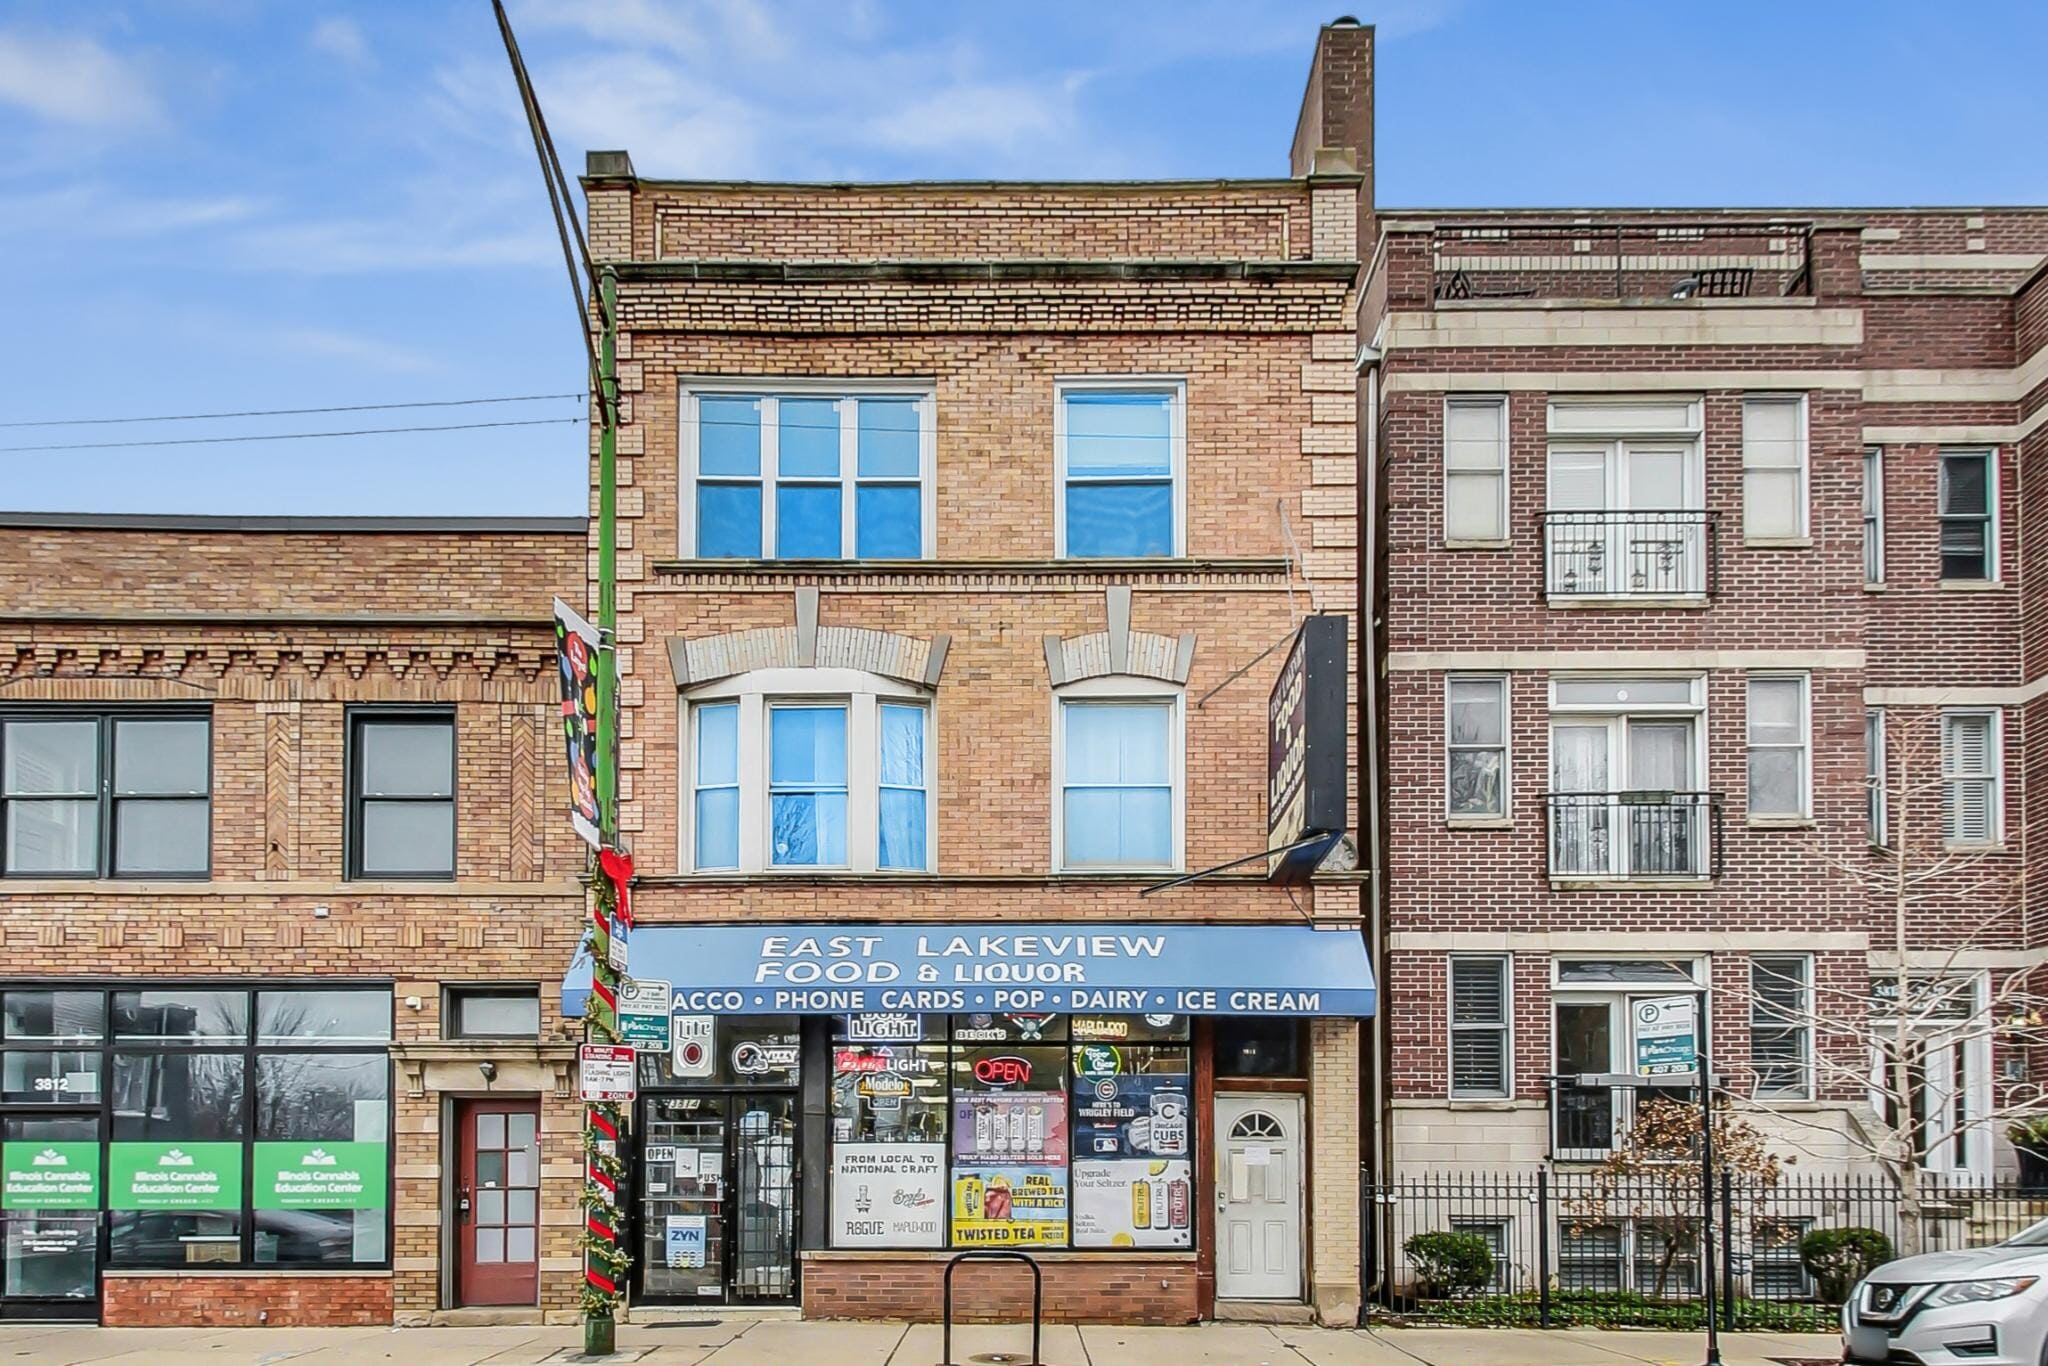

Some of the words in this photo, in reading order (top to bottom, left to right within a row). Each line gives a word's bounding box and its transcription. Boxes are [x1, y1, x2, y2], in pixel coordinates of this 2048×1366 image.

[1275, 672, 1302, 743] FOOD
[1270, 724, 1305, 809] LIQUOR
[760, 936, 884, 957] EAST
[917, 936, 1167, 957] LAKEVIEW
[754, 961, 900, 983] FOOD
[917, 964, 940, 983] &
[954, 963, 1086, 983] LIQUOR
[671, 991, 743, 1010] ACCO
[775, 991, 864, 1009] PHONE
[881, 990, 964, 1009] CARDS
[995, 990, 1045, 1009] POP
[1071, 990, 1148, 1009] DAIRY
[1177, 991, 1217, 1009] ICE
[1229, 991, 1320, 1011] CREAM
[675, 1019, 711, 1040] Lite
[955, 1028, 1007, 1040] BECK'S
[763, 1049, 798, 1063] VIZZY
[886, 1058, 928, 1072] LIGHT
[975, 1060, 1031, 1083] OPEN
[34, 1078, 69, 1091] 3812
[865, 1076, 905, 1091] Modelo
[1078, 1108, 1112, 1117] WRIGLEY
[1113, 1108, 1135, 1117] FIELD
[1153, 1130, 1184, 1141] CUBS
[648, 1148, 674, 1160] OPEN
[845, 1155, 876, 1164] FROM
[880, 1155, 915, 1164] LOCAL
[920, 1155, 935, 1164] TO
[841, 1165, 896, 1174] NATIONAL
[901, 1165, 938, 1174] CRAFT
[1074, 1169, 1111, 1179] Upgrade
[44, 1171, 91, 1181] Cannabis
[170, 1171, 218, 1181] Cannabis
[312, 1171, 360, 1181] Cannabis
[1025, 1176, 1050, 1186] REAL
[6, 1183, 58, 1193] Education
[59, 1183, 94, 1193] Center
[132, 1183, 184, 1193] Education
[184, 1183, 220, 1193] Center
[275, 1183, 326, 1193] Education
[327, 1183, 363, 1193] Center
[1074, 1180, 1095, 1188] Your
[1096, 1180, 1128, 1188] Seltzer.
[1012, 1188, 1047, 1196] BREWED
[1049, 1187, 1065, 1195] TEA
[1013, 1198, 1035, 1207] WITH
[1036, 1199, 1042, 1207] A
[1044, 1198, 1065, 1207] KICK
[846, 1221, 885, 1236] ROGUE
[956, 1228, 1010, 1241] TWISTED
[1012, 1227, 1036, 1240] TEA
[671, 1230, 700, 1241] ZYN
[1041, 1231, 1065, 1240] INSIDE
